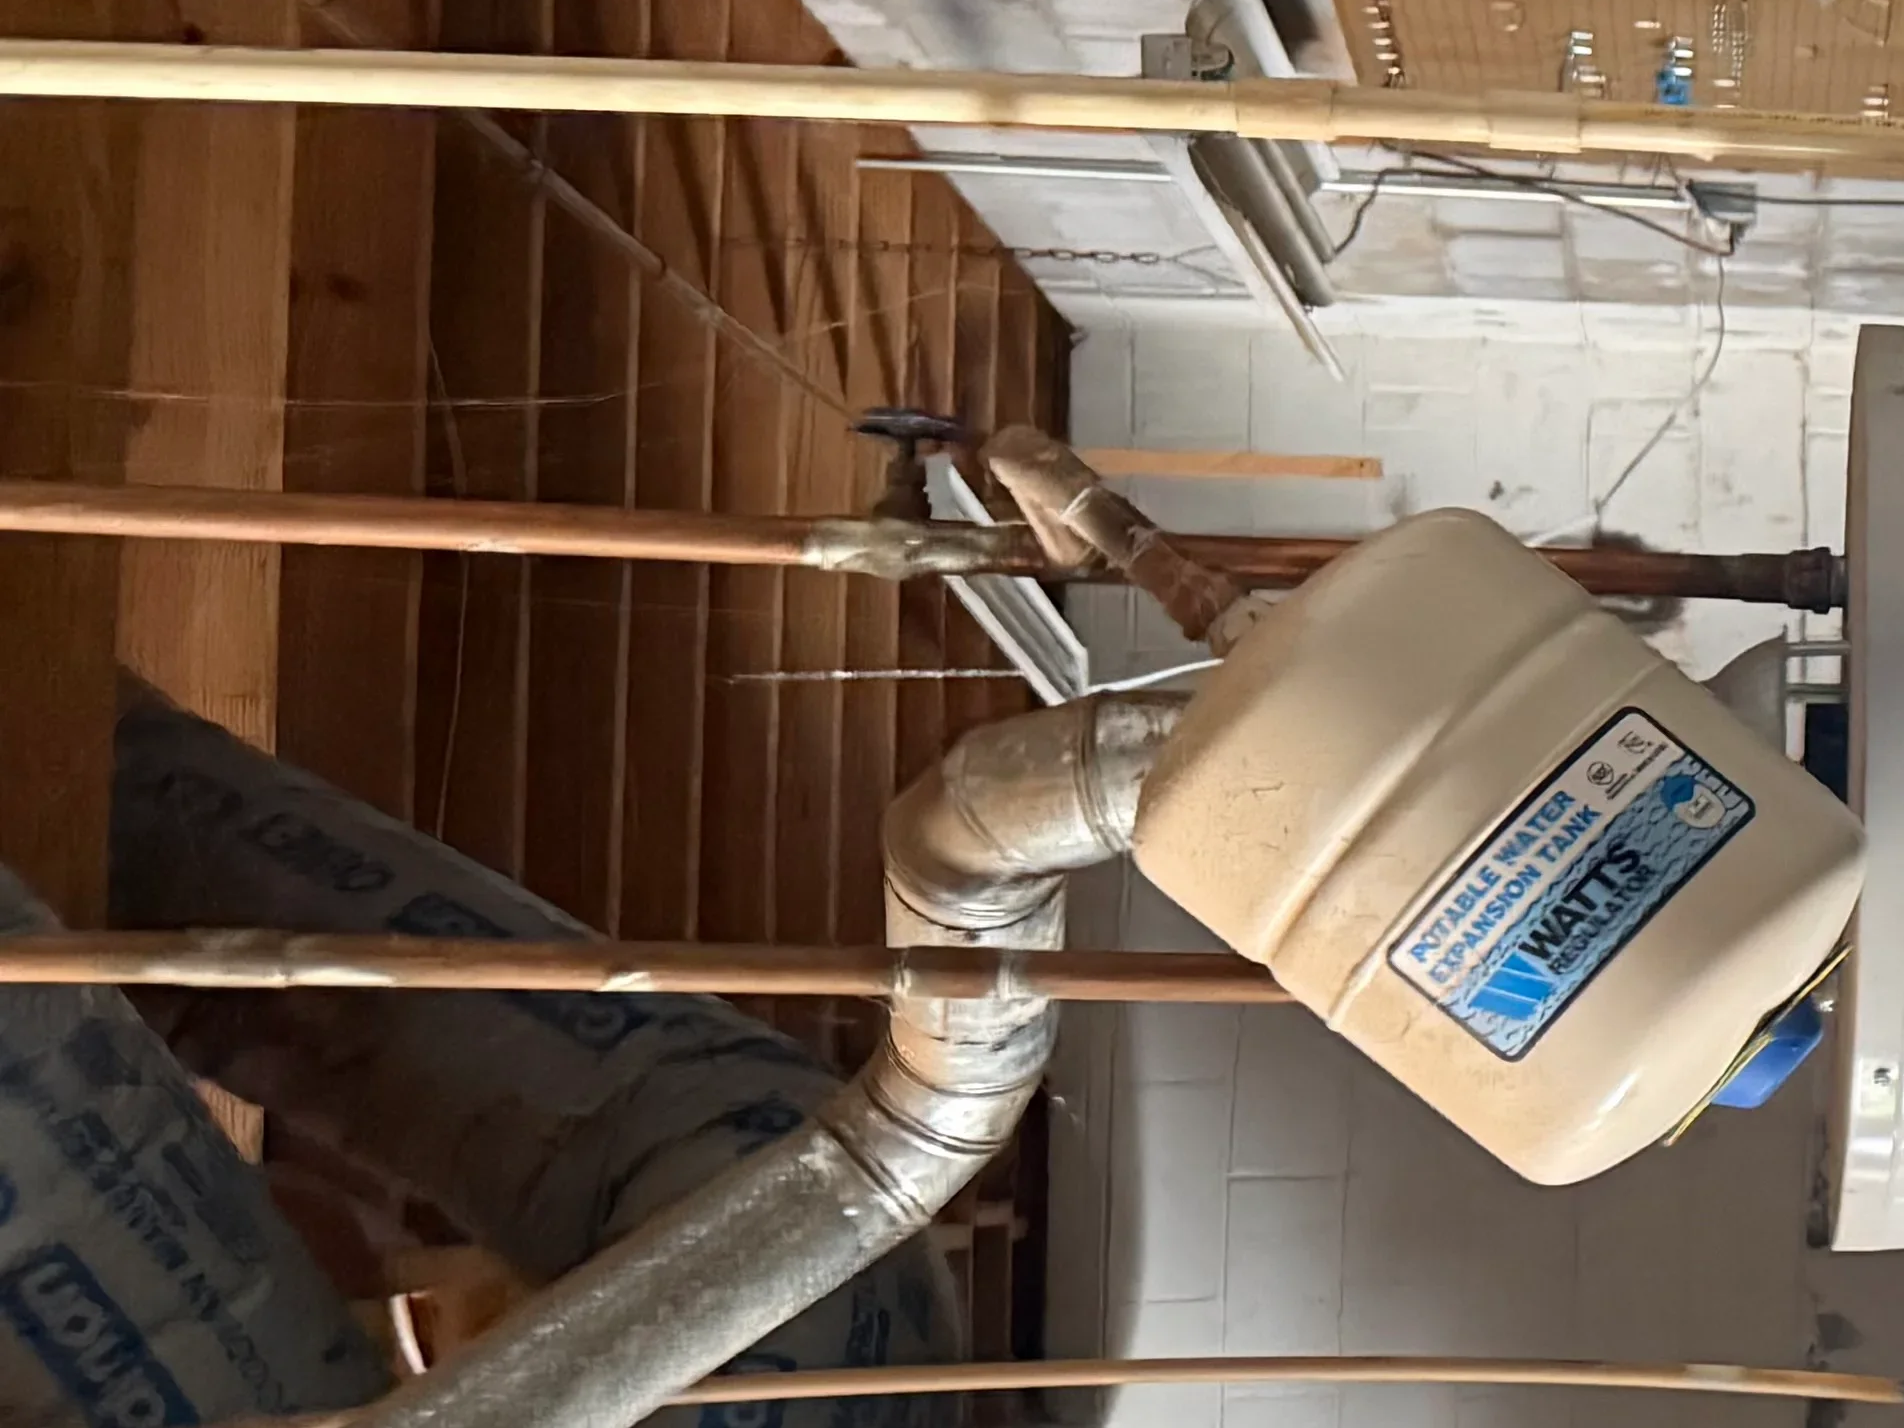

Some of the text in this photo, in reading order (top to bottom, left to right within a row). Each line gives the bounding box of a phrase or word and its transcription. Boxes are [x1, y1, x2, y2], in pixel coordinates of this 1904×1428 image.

[1407, 791, 1576, 963] POTABLE WATER
[1429, 803, 1603, 983] EXPANSION TANK
[1516, 842, 1642, 962] WATTS
[1546, 863, 1655, 975] REGULATOR
